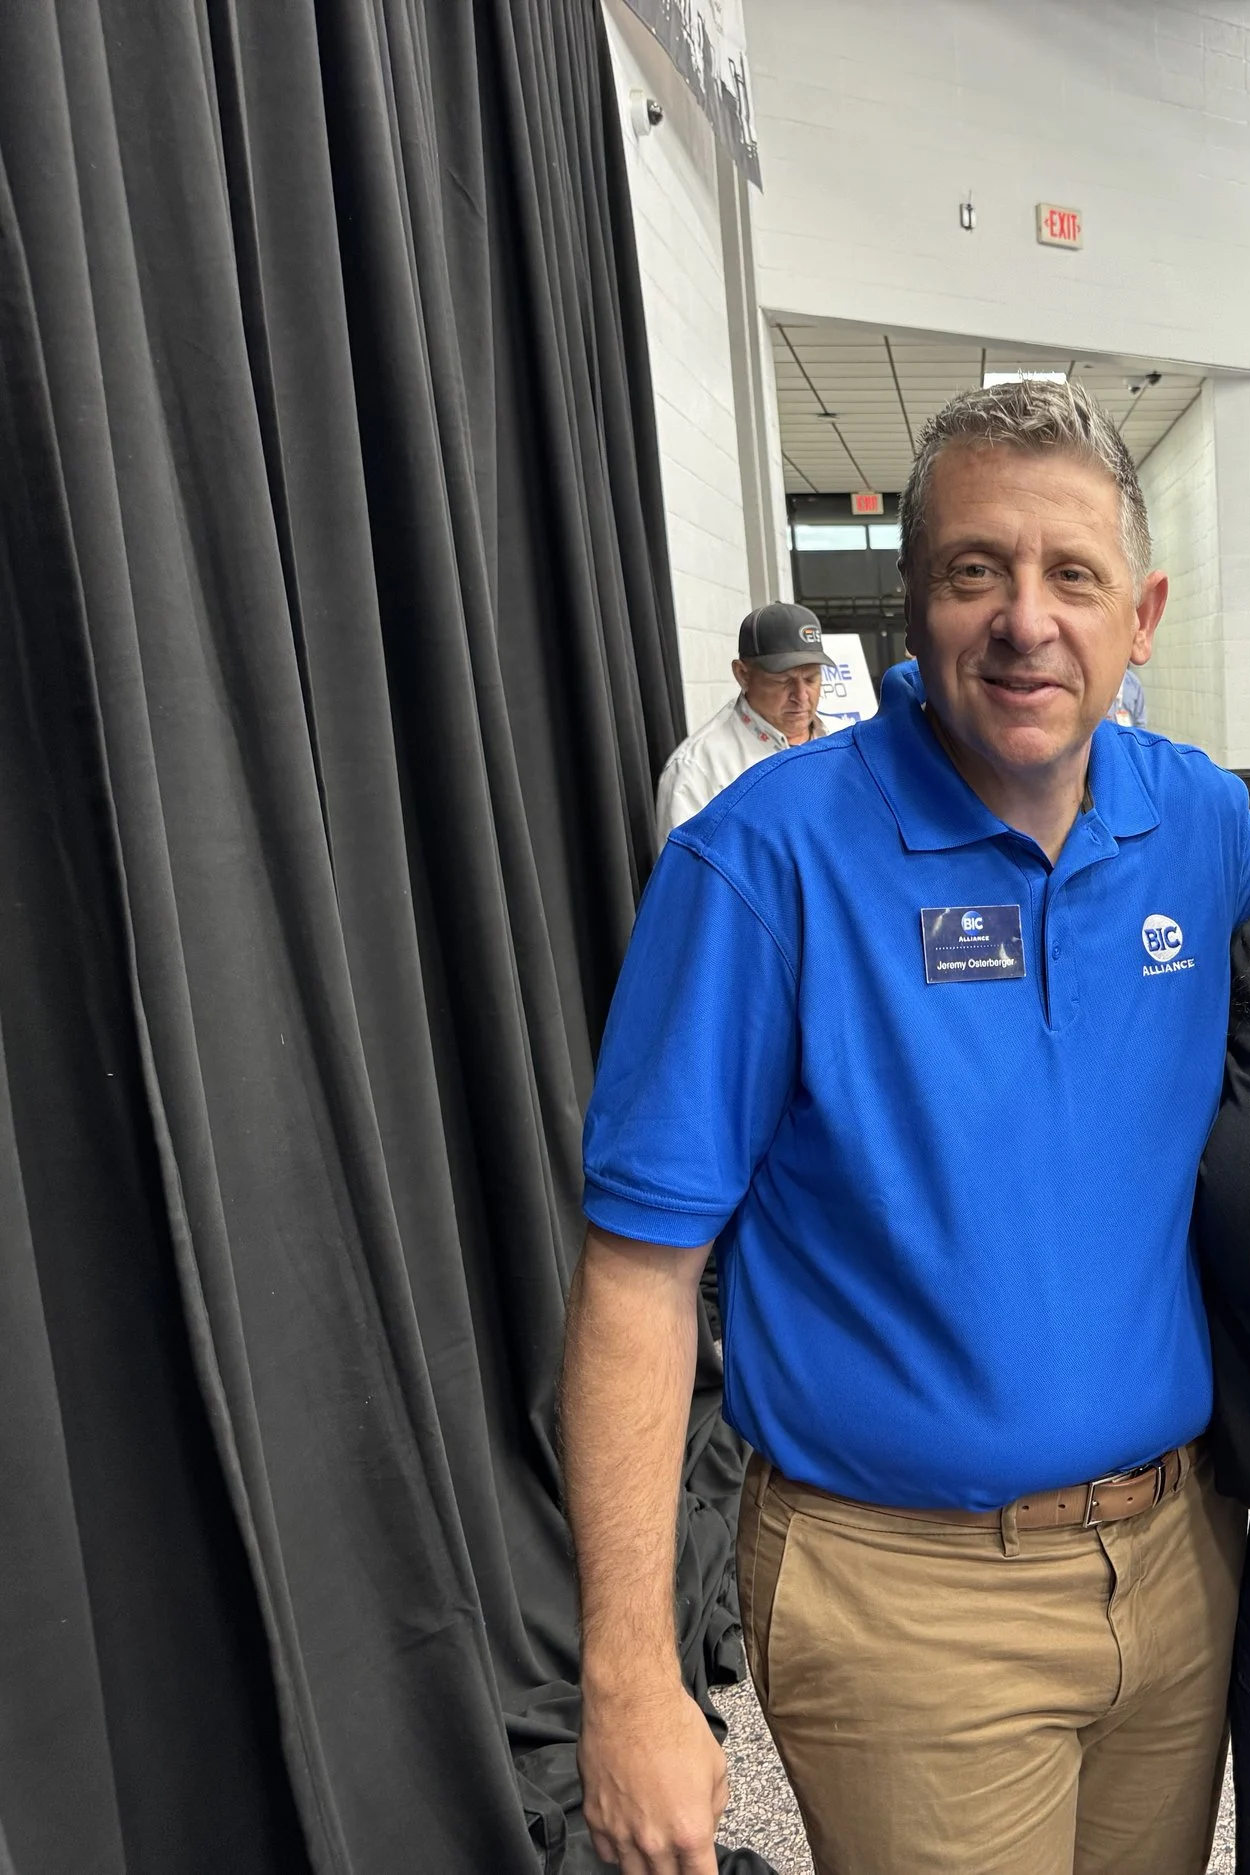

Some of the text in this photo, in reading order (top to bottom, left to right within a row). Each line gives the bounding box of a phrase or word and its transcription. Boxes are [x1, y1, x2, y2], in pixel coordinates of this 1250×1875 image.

[1049, 210, 1077, 241] EXIT
[963, 917, 984, 931] BIC
[959, 935, 990, 943] ALLIANCE
[1144, 926, 1181, 952] BIC
[937, 957, 1015, 971] Jeremy Osterberger
[1143, 958, 1195, 977] ALLIANCE
